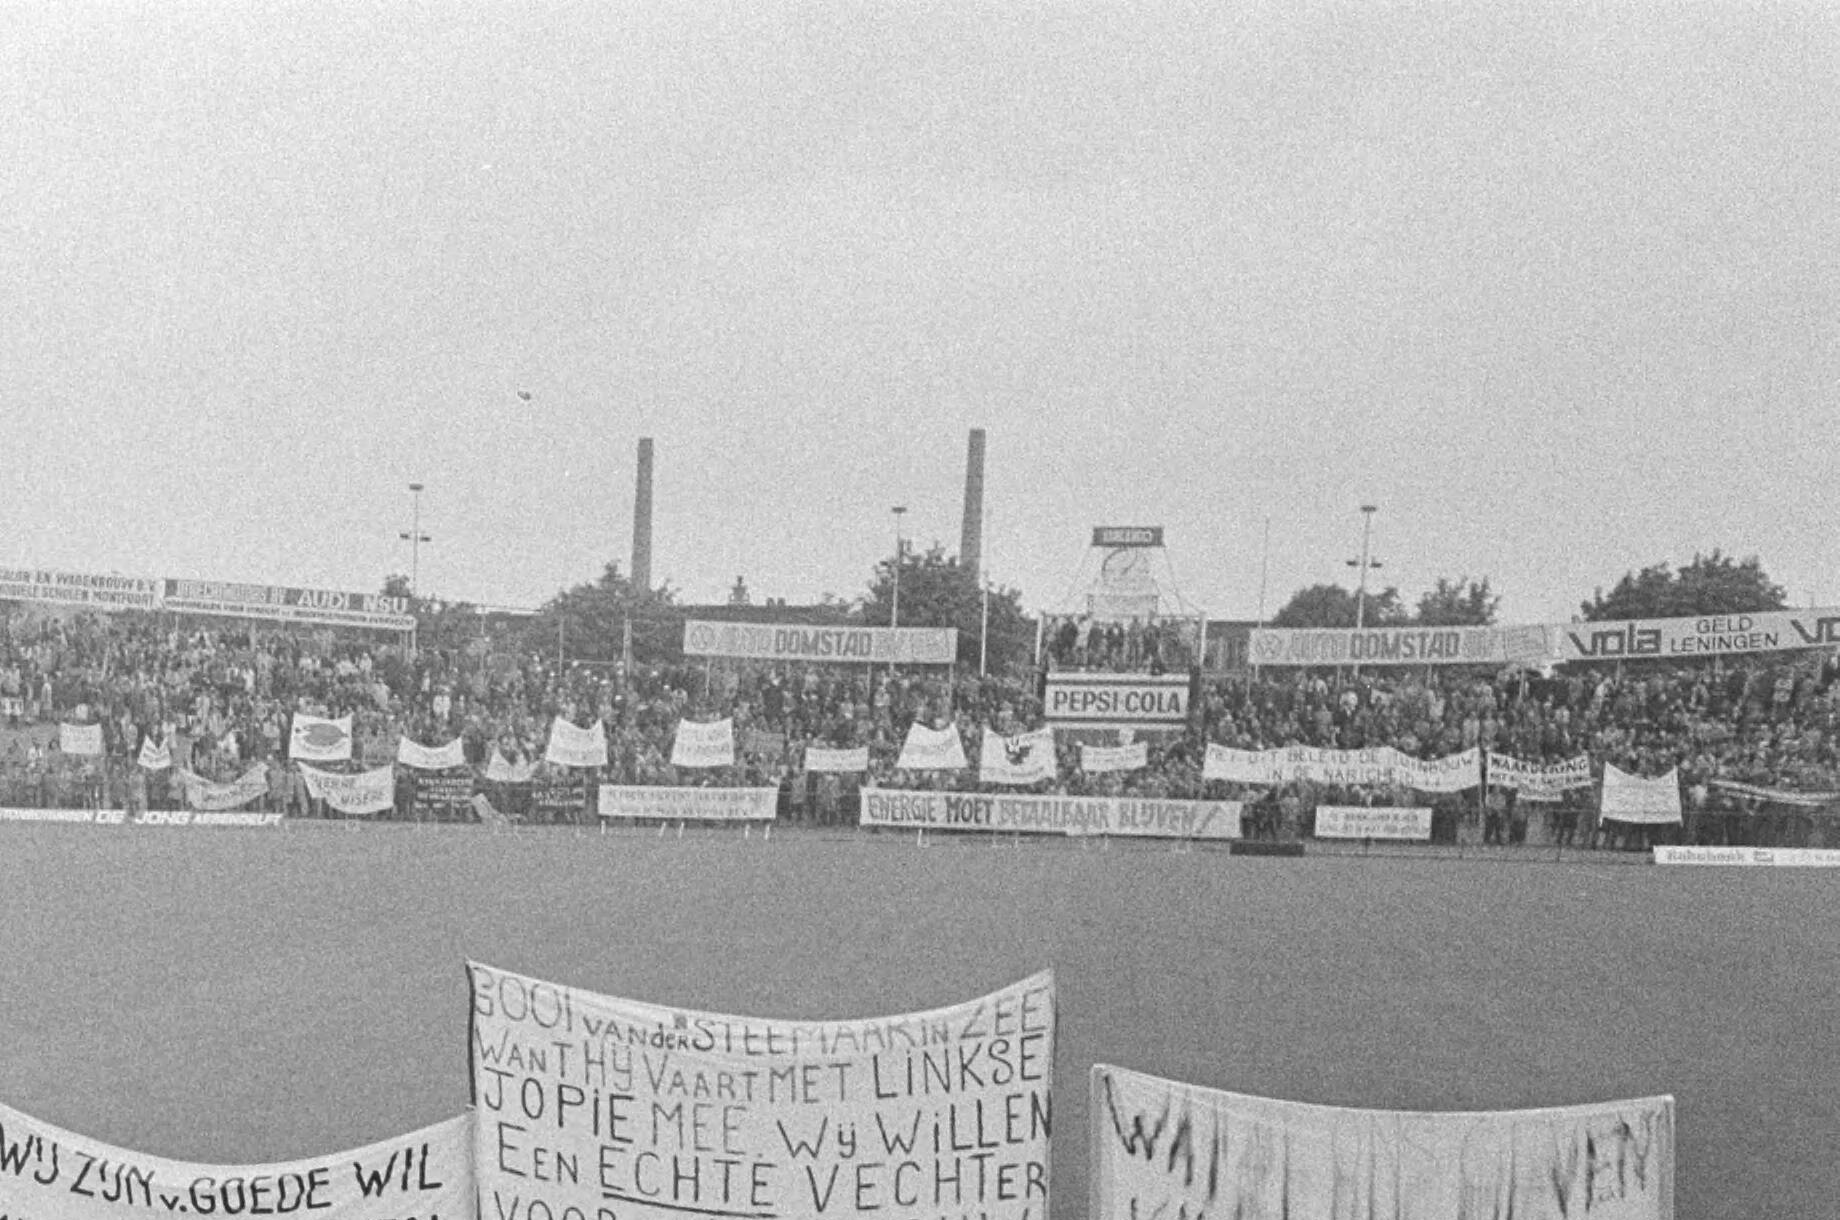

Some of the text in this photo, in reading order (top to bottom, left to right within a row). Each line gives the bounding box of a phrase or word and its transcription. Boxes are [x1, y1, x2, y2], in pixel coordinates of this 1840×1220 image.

[297, 588, 350, 610] AUDI
[362, 594, 409, 613] NSU
[1696, 616, 1753, 634] GELD
[773, 629, 872, 656] DOMSTAD
[1350, 632, 1460, 659] DOMSTAD
[1671, 632, 1779, 653] LENINGEN
[95, 810, 126, 824] DE
[134, 811, 192, 825] JONG
[867, 794, 936, 824] ENERGIE
[945, 796, 992, 823] MOET
[1000, 799, 1109, 828] BETAALBAAR
[959, 985, 1049, 1040] ZEE
[474, 1023, 573, 1079] WANT
[642, 1050, 759, 1102] VAART
[769, 1062, 852, 1104] MET
[188, 1166, 333, 1215] GOEDE
[353, 1142, 443, 1199] WIL
[497, 1121, 1047, 1213] EEN ECHTE VECHTER
